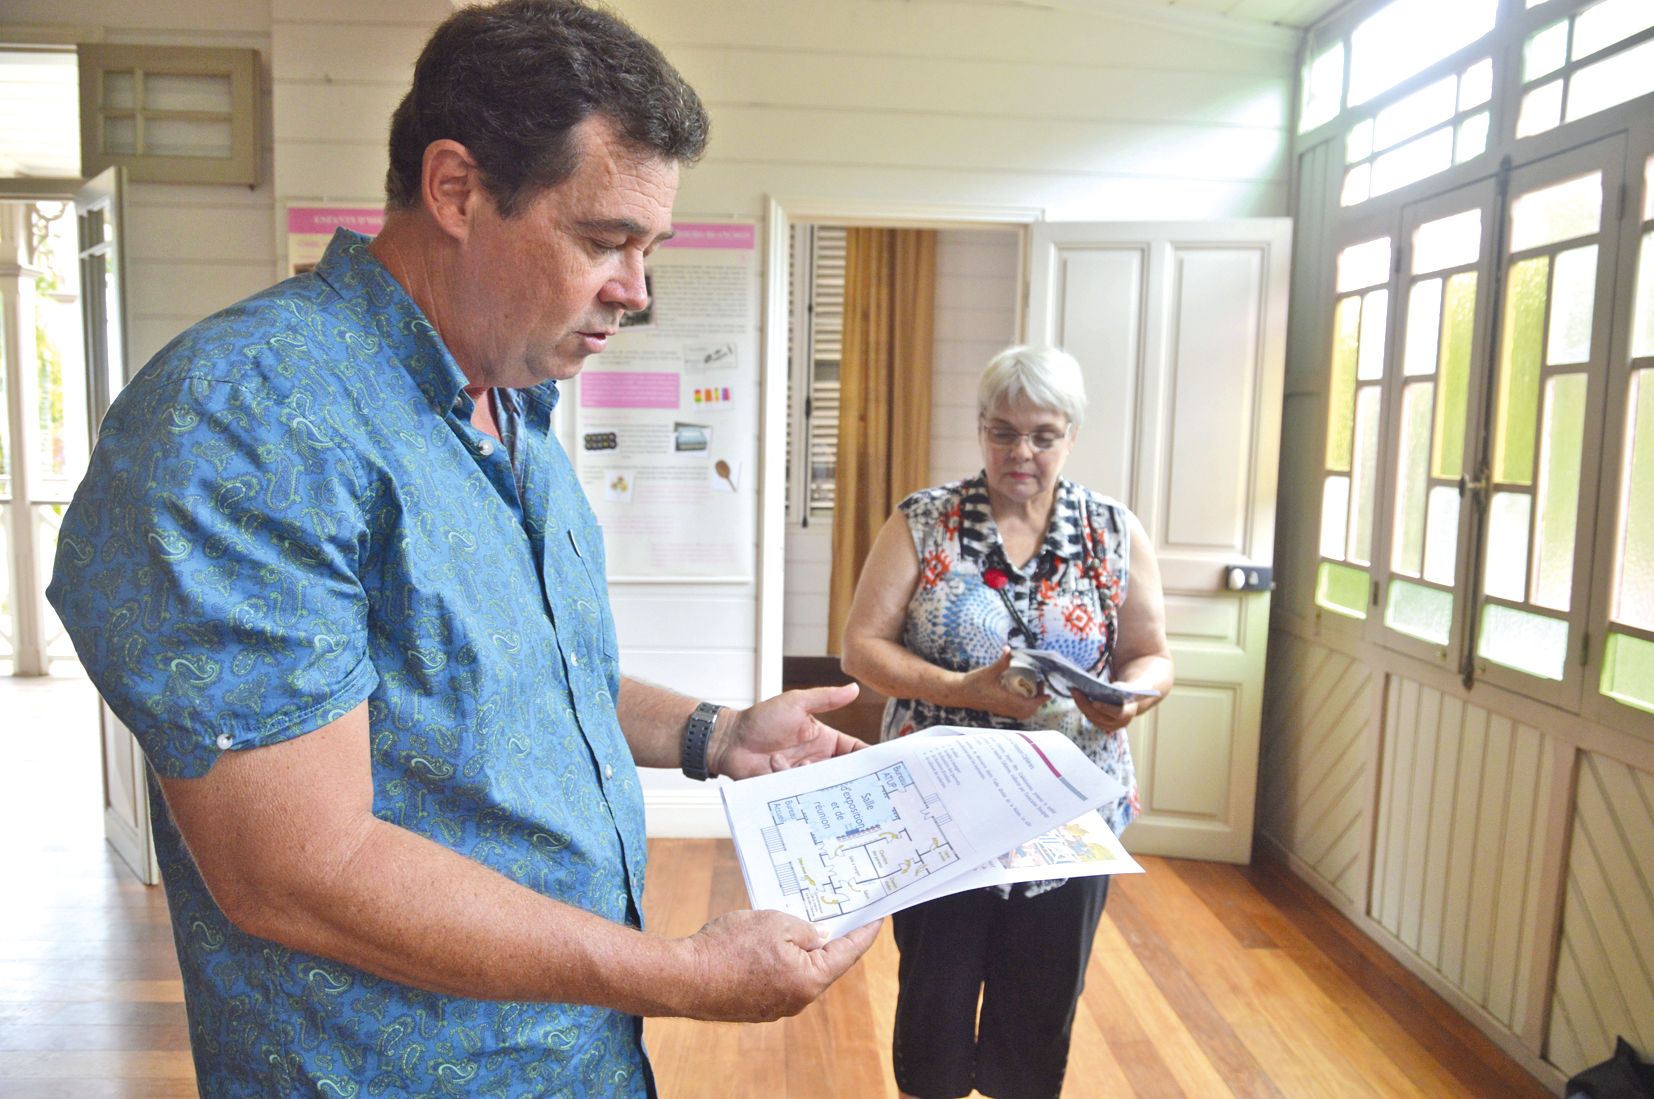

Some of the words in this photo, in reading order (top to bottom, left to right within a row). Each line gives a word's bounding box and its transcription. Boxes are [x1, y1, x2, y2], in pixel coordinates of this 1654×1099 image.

[883, 772, 897, 788] ATUP
[893, 765, 906, 786] Bureau
[784, 799, 796, 820] Bureau
[830, 801, 839, 811] et
[840, 784, 865, 829] d'exposition
[861, 792, 874, 811] Salle
[773, 803, 784, 823] Accueil
[814, 801, 831, 830] réunion
[834, 810, 843, 821] de
